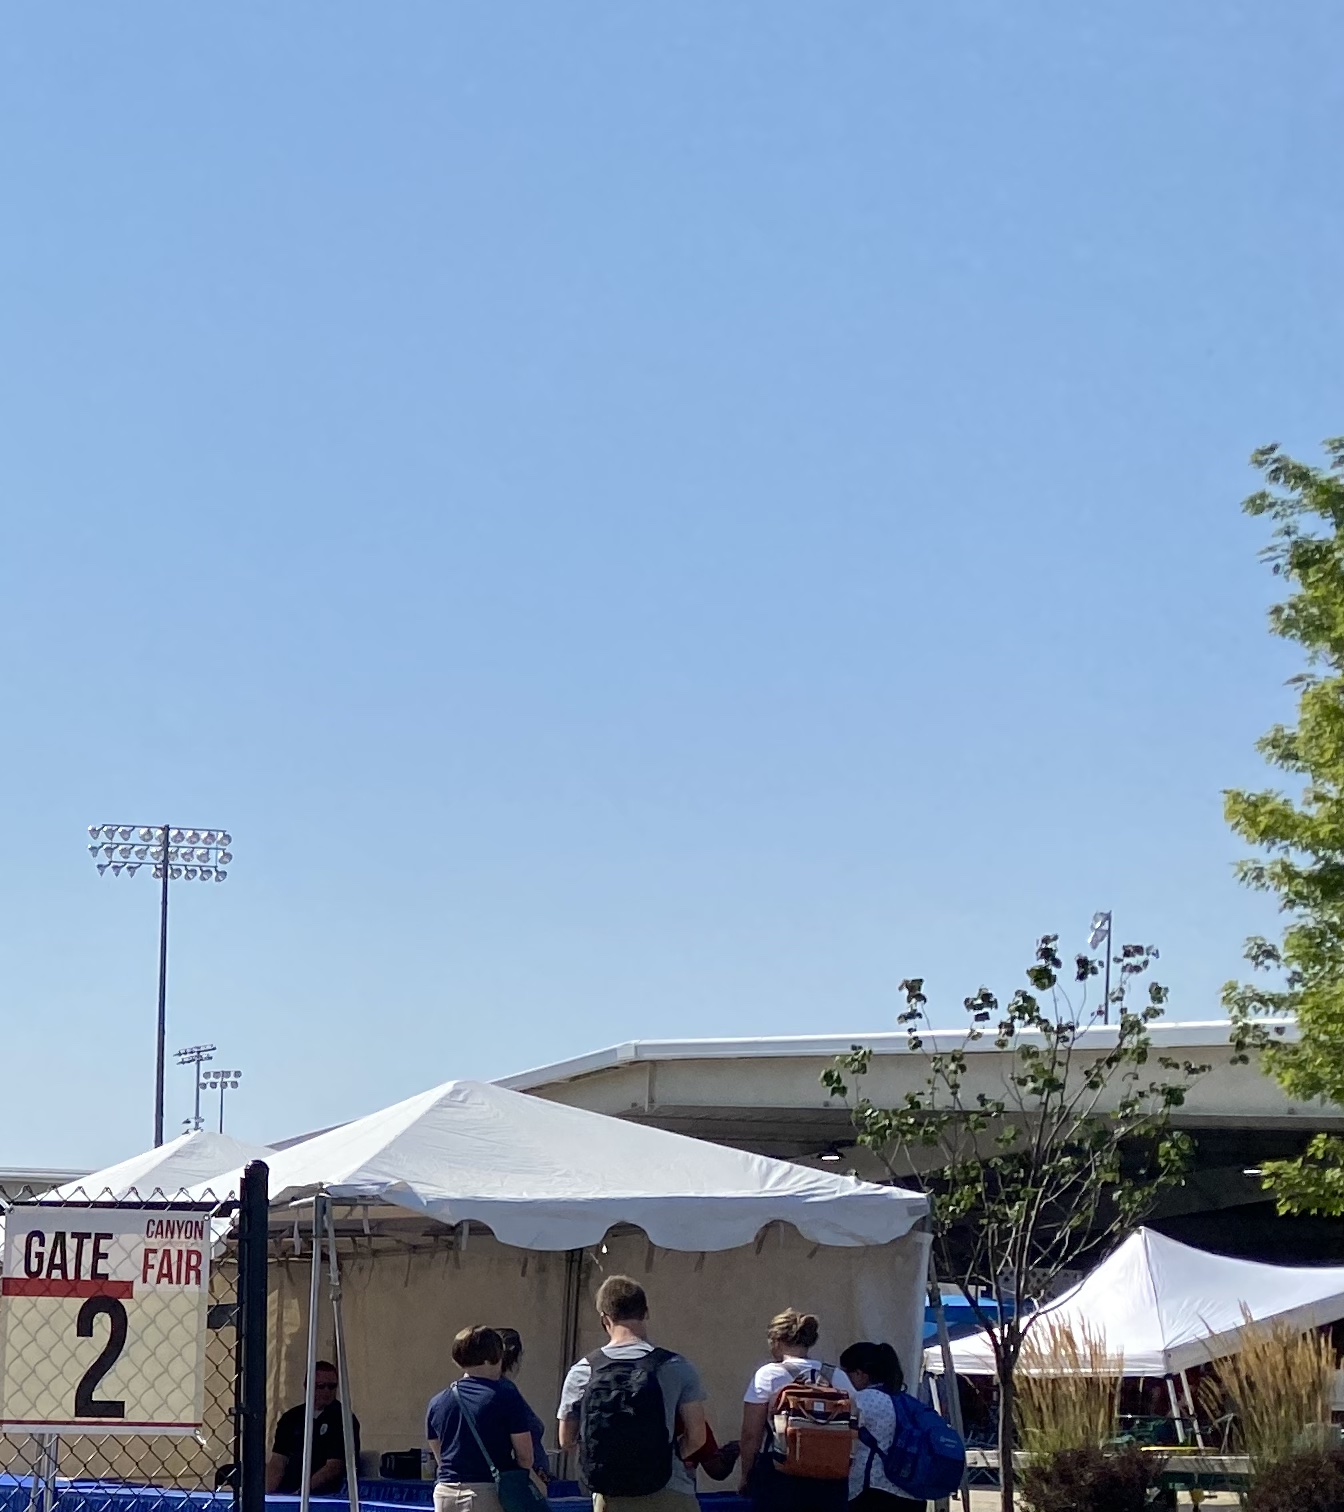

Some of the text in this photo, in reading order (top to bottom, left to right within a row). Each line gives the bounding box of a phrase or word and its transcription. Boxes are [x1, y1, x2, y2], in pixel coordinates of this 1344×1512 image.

[145, 1218, 205, 1240] CANYON
[24, 1229, 113, 1281] GATE
[141, 1247, 203, 1286] FAIR
[74, 1294, 128, 1418] 2
